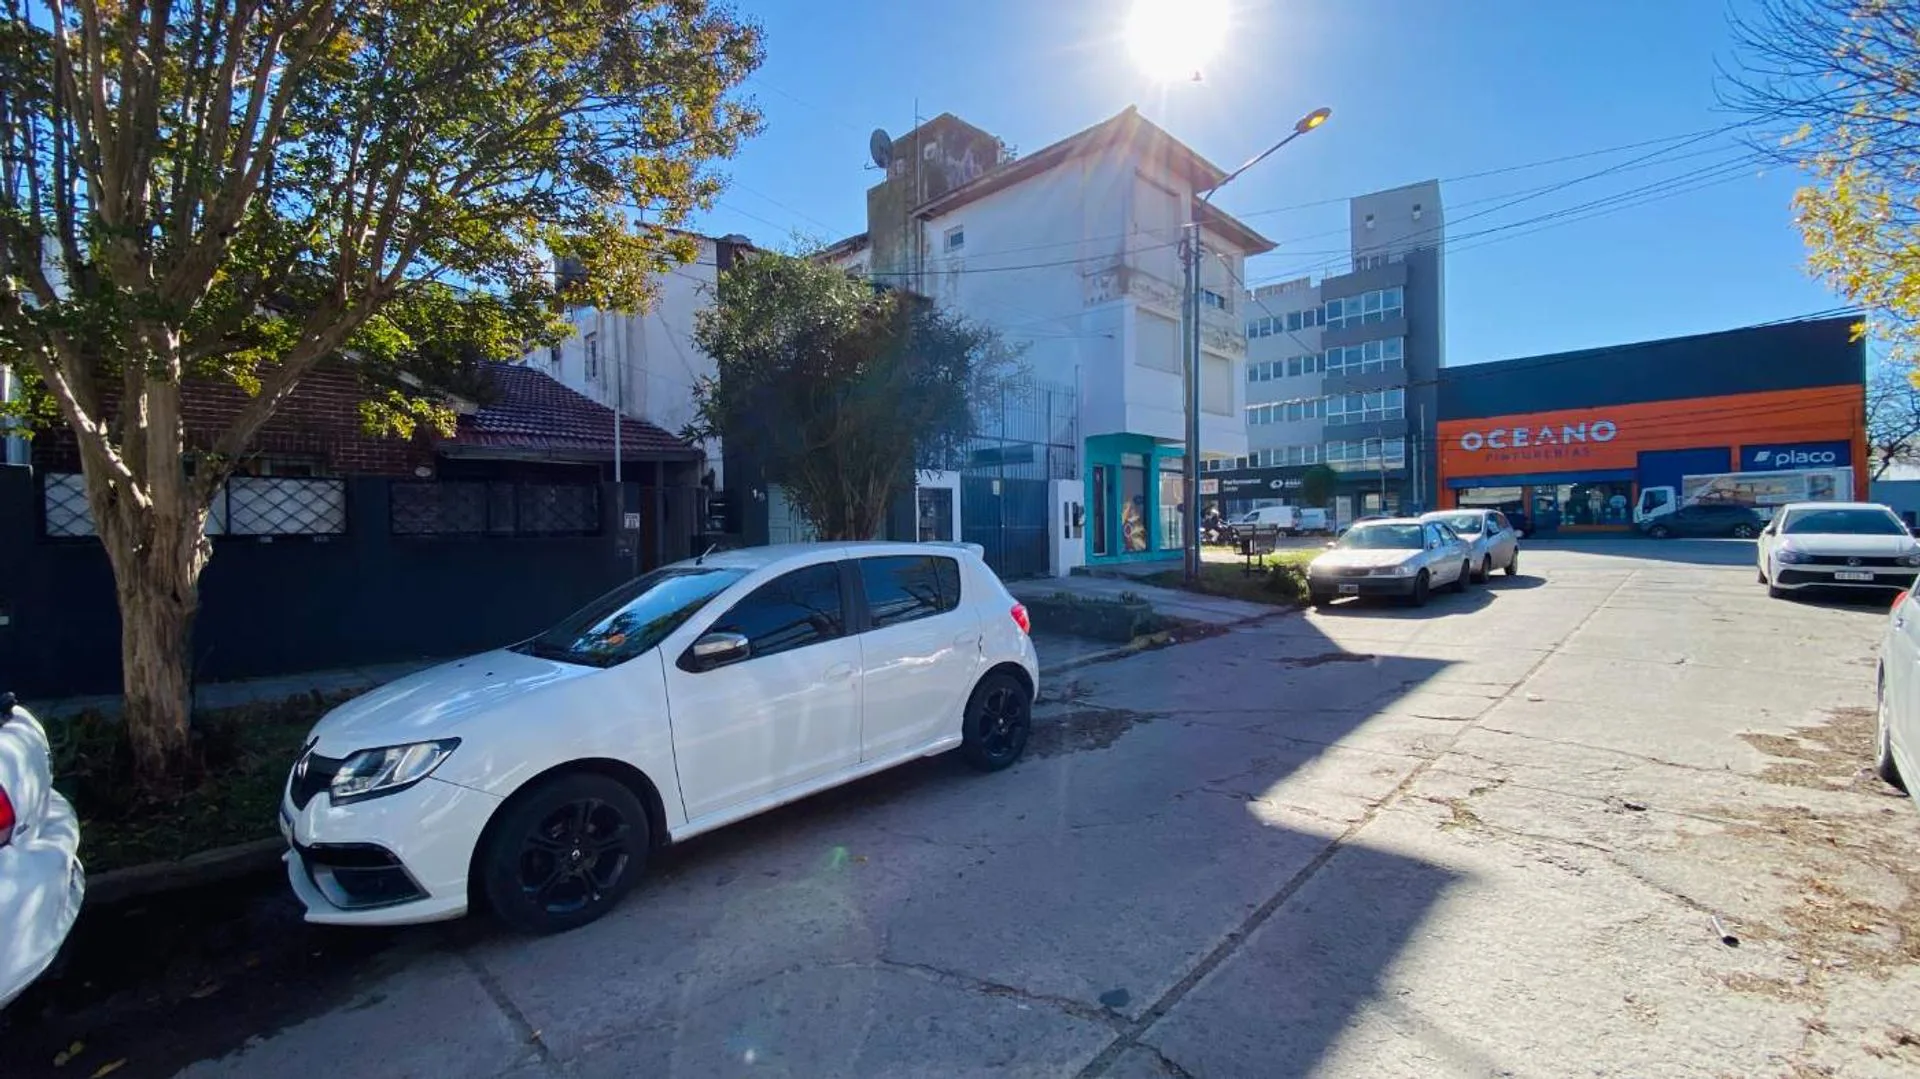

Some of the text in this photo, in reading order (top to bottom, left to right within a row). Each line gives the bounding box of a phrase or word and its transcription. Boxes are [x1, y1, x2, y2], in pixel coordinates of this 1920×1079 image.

[1460, 420, 1617, 452] OCEANO
[1485, 446, 1591, 462] PINTURERIAS
[1776, 449, 1836, 467] placo
